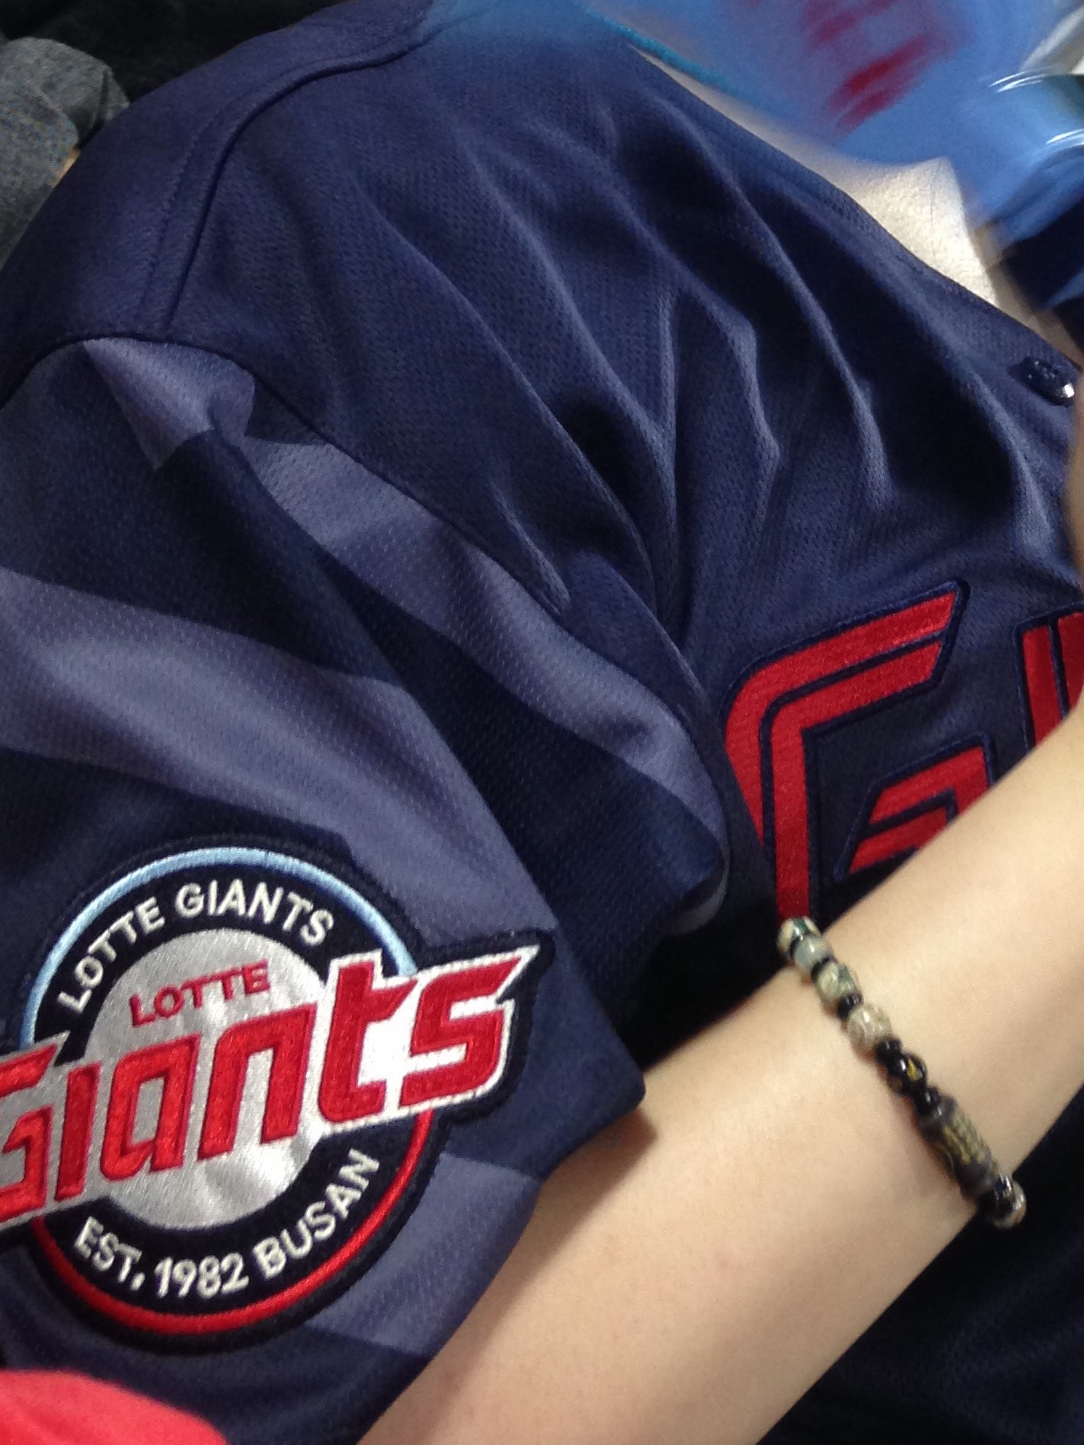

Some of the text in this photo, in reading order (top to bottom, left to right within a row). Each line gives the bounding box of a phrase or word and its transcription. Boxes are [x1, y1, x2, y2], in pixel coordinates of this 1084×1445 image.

[57, 879, 335, 1014] LOTTE GIANTS
[128, 959, 272, 1028] LOTTE
[73, 1148, 380, 1299] EST. 1982 BUSAN
